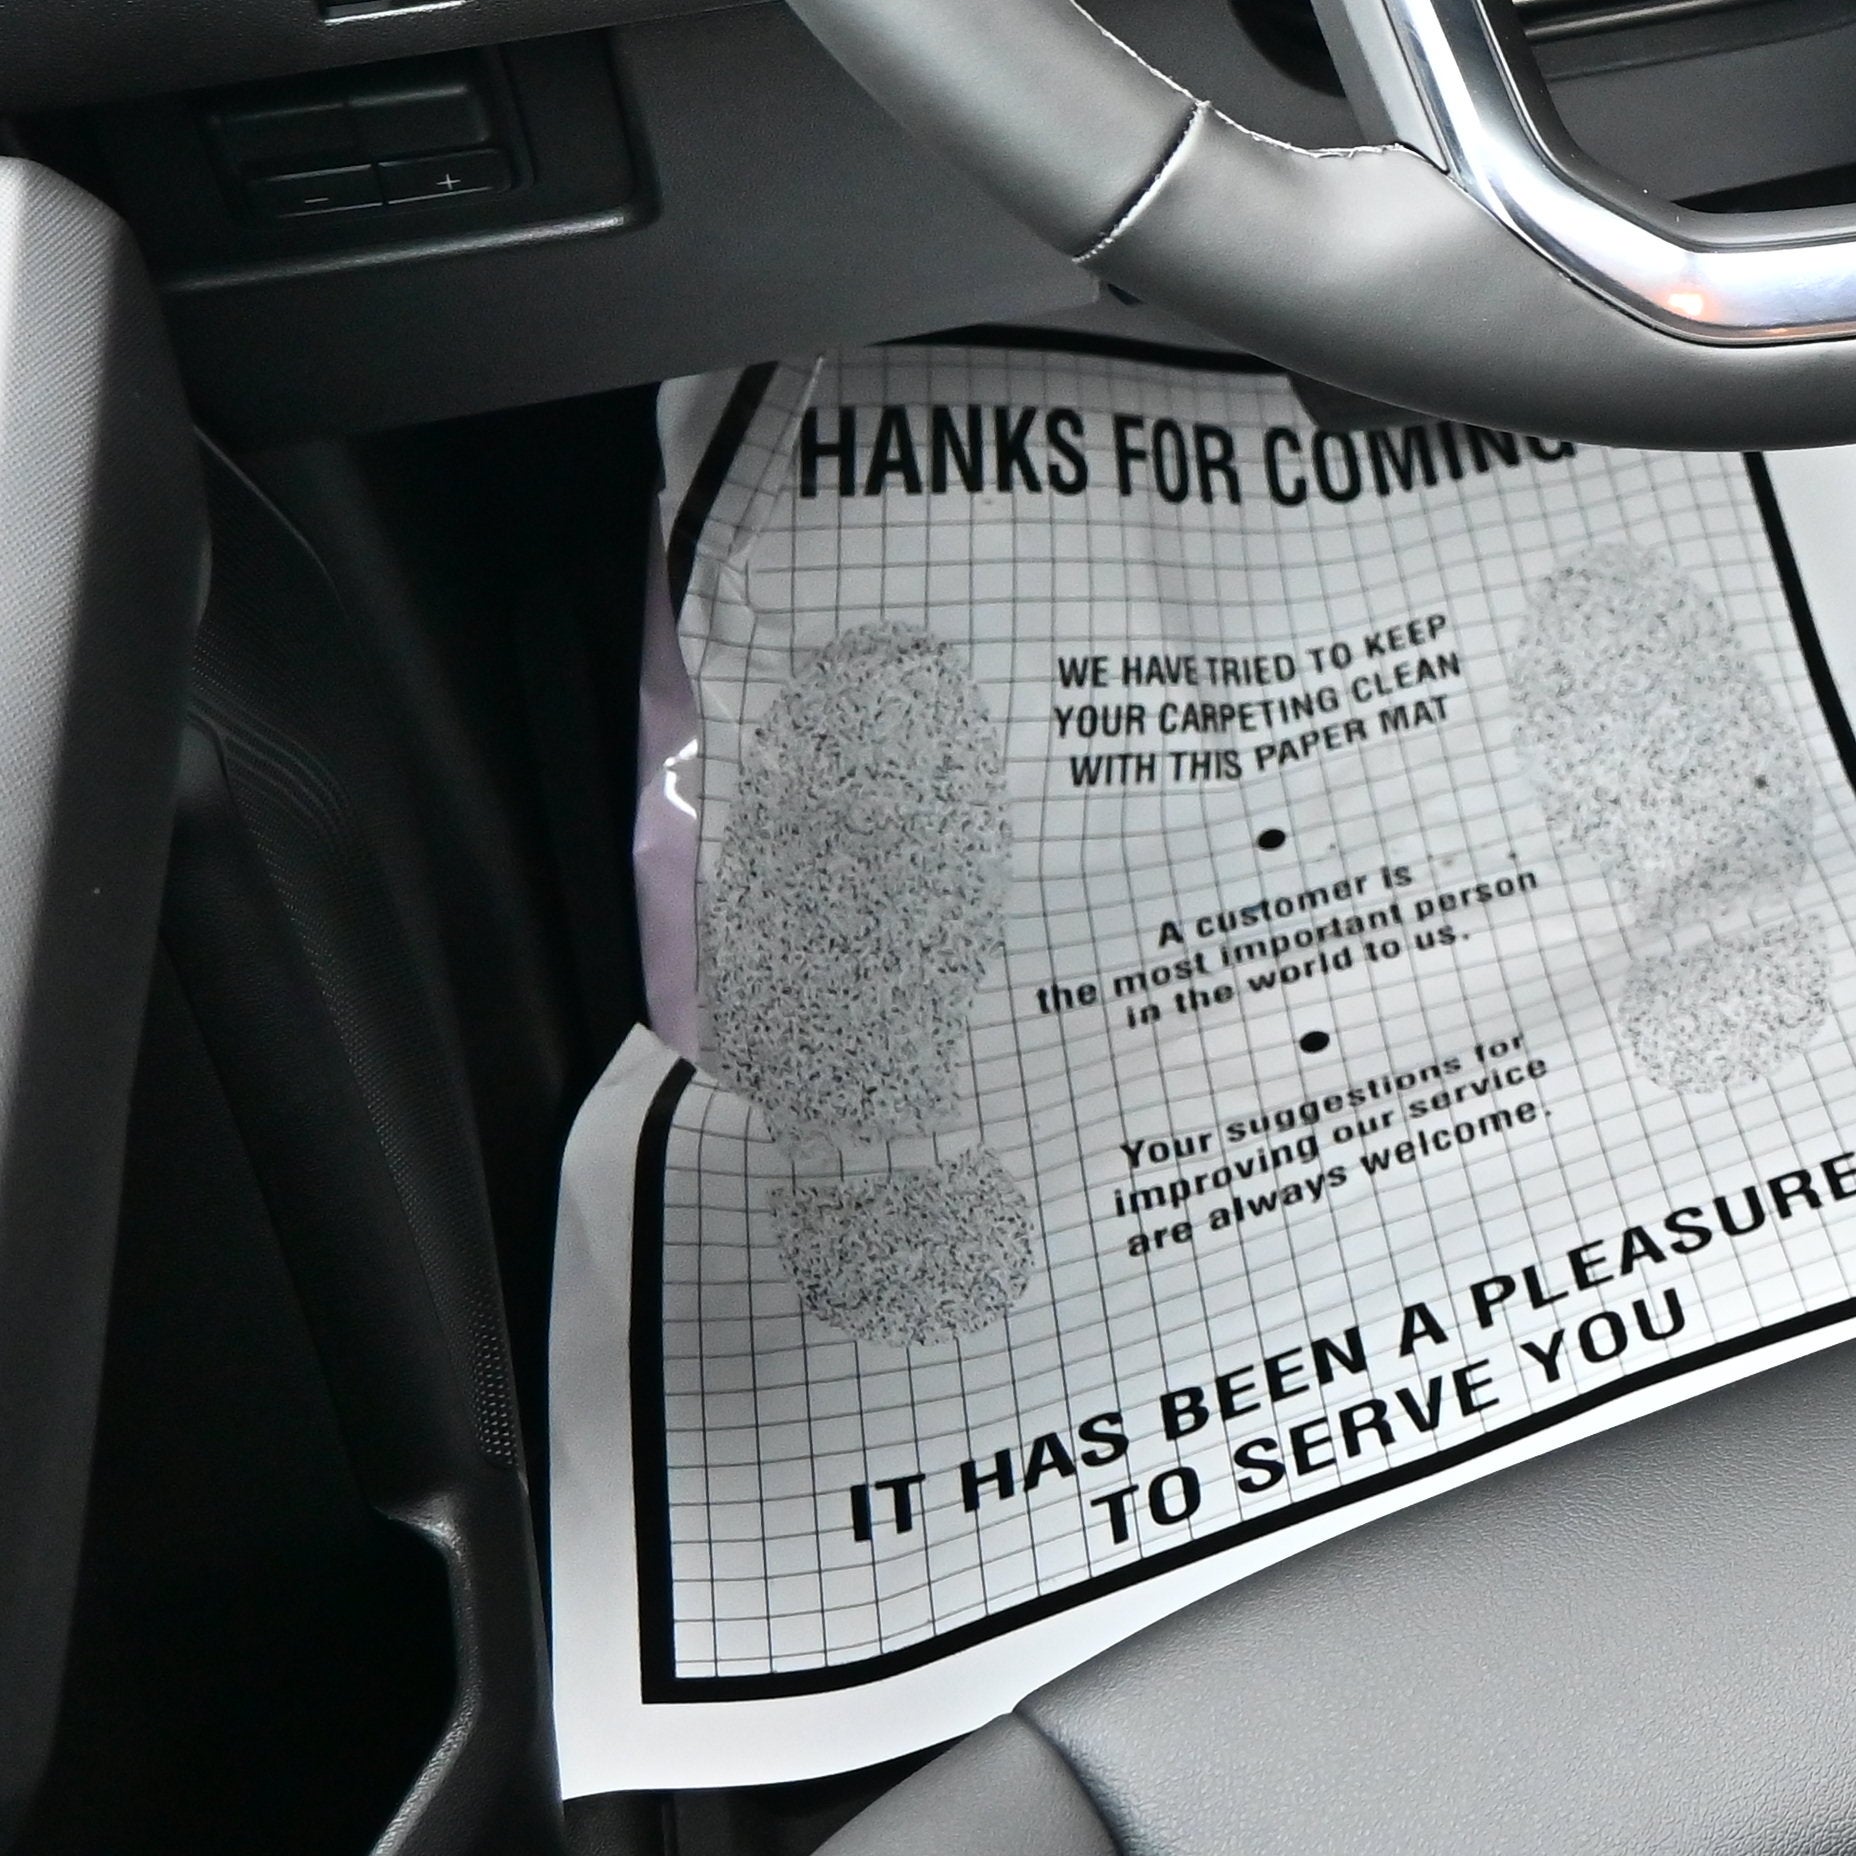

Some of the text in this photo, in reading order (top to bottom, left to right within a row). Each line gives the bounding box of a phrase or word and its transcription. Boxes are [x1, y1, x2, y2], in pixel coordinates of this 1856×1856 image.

[1114, 413, 1242, 507] FOR
[1054, 652, 1462, 739] YOUR CARPETING CLEAN
[1059, 614, 1448, 688] WE HAVE TRIED TO KEEP
[1070, 694, 1450, 787] WITH THIS PAPER MAT
[1036, 869, 1538, 1015] the most important person
[1158, 864, 1413, 948] A customer is
[1126, 924, 1471, 1029] in the world to us.
[1113, 1055, 1549, 1217] improving our service
[1120, 1032, 1525, 1170] Your suggestions for
[1127, 1099, 1552, 1258] are always welcome.
[848, 1471, 926, 1544] IT
[959, 1410, 1130, 1516] HAS
[1160, 1321, 1373, 1442] BEEN
[1397, 1303, 1450, 1358] A
[1090, 1288, 1692, 1546] TO SERVE YOU
